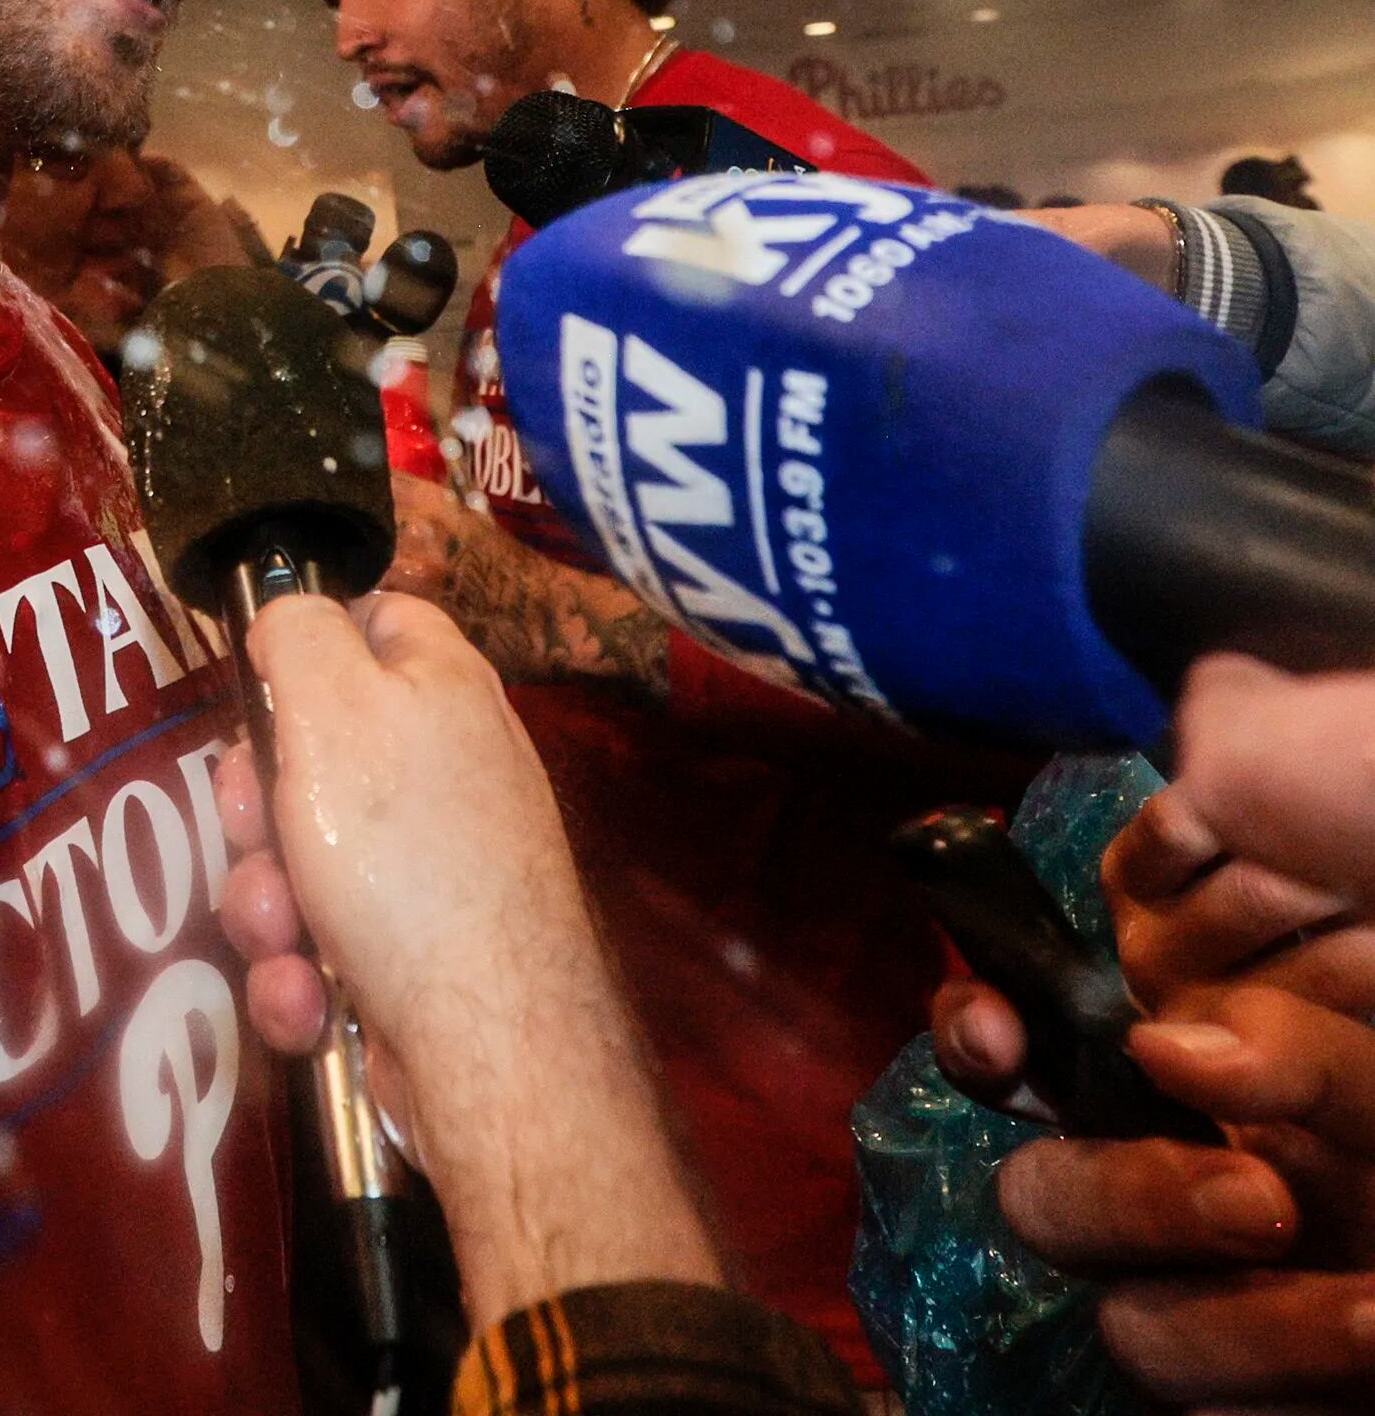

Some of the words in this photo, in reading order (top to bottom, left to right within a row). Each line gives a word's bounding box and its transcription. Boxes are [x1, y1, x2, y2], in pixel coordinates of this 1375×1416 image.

[811, 237, 916, 323] 1060
[776, 367, 829, 456] FM
[777, 458, 838, 595] 103.9
